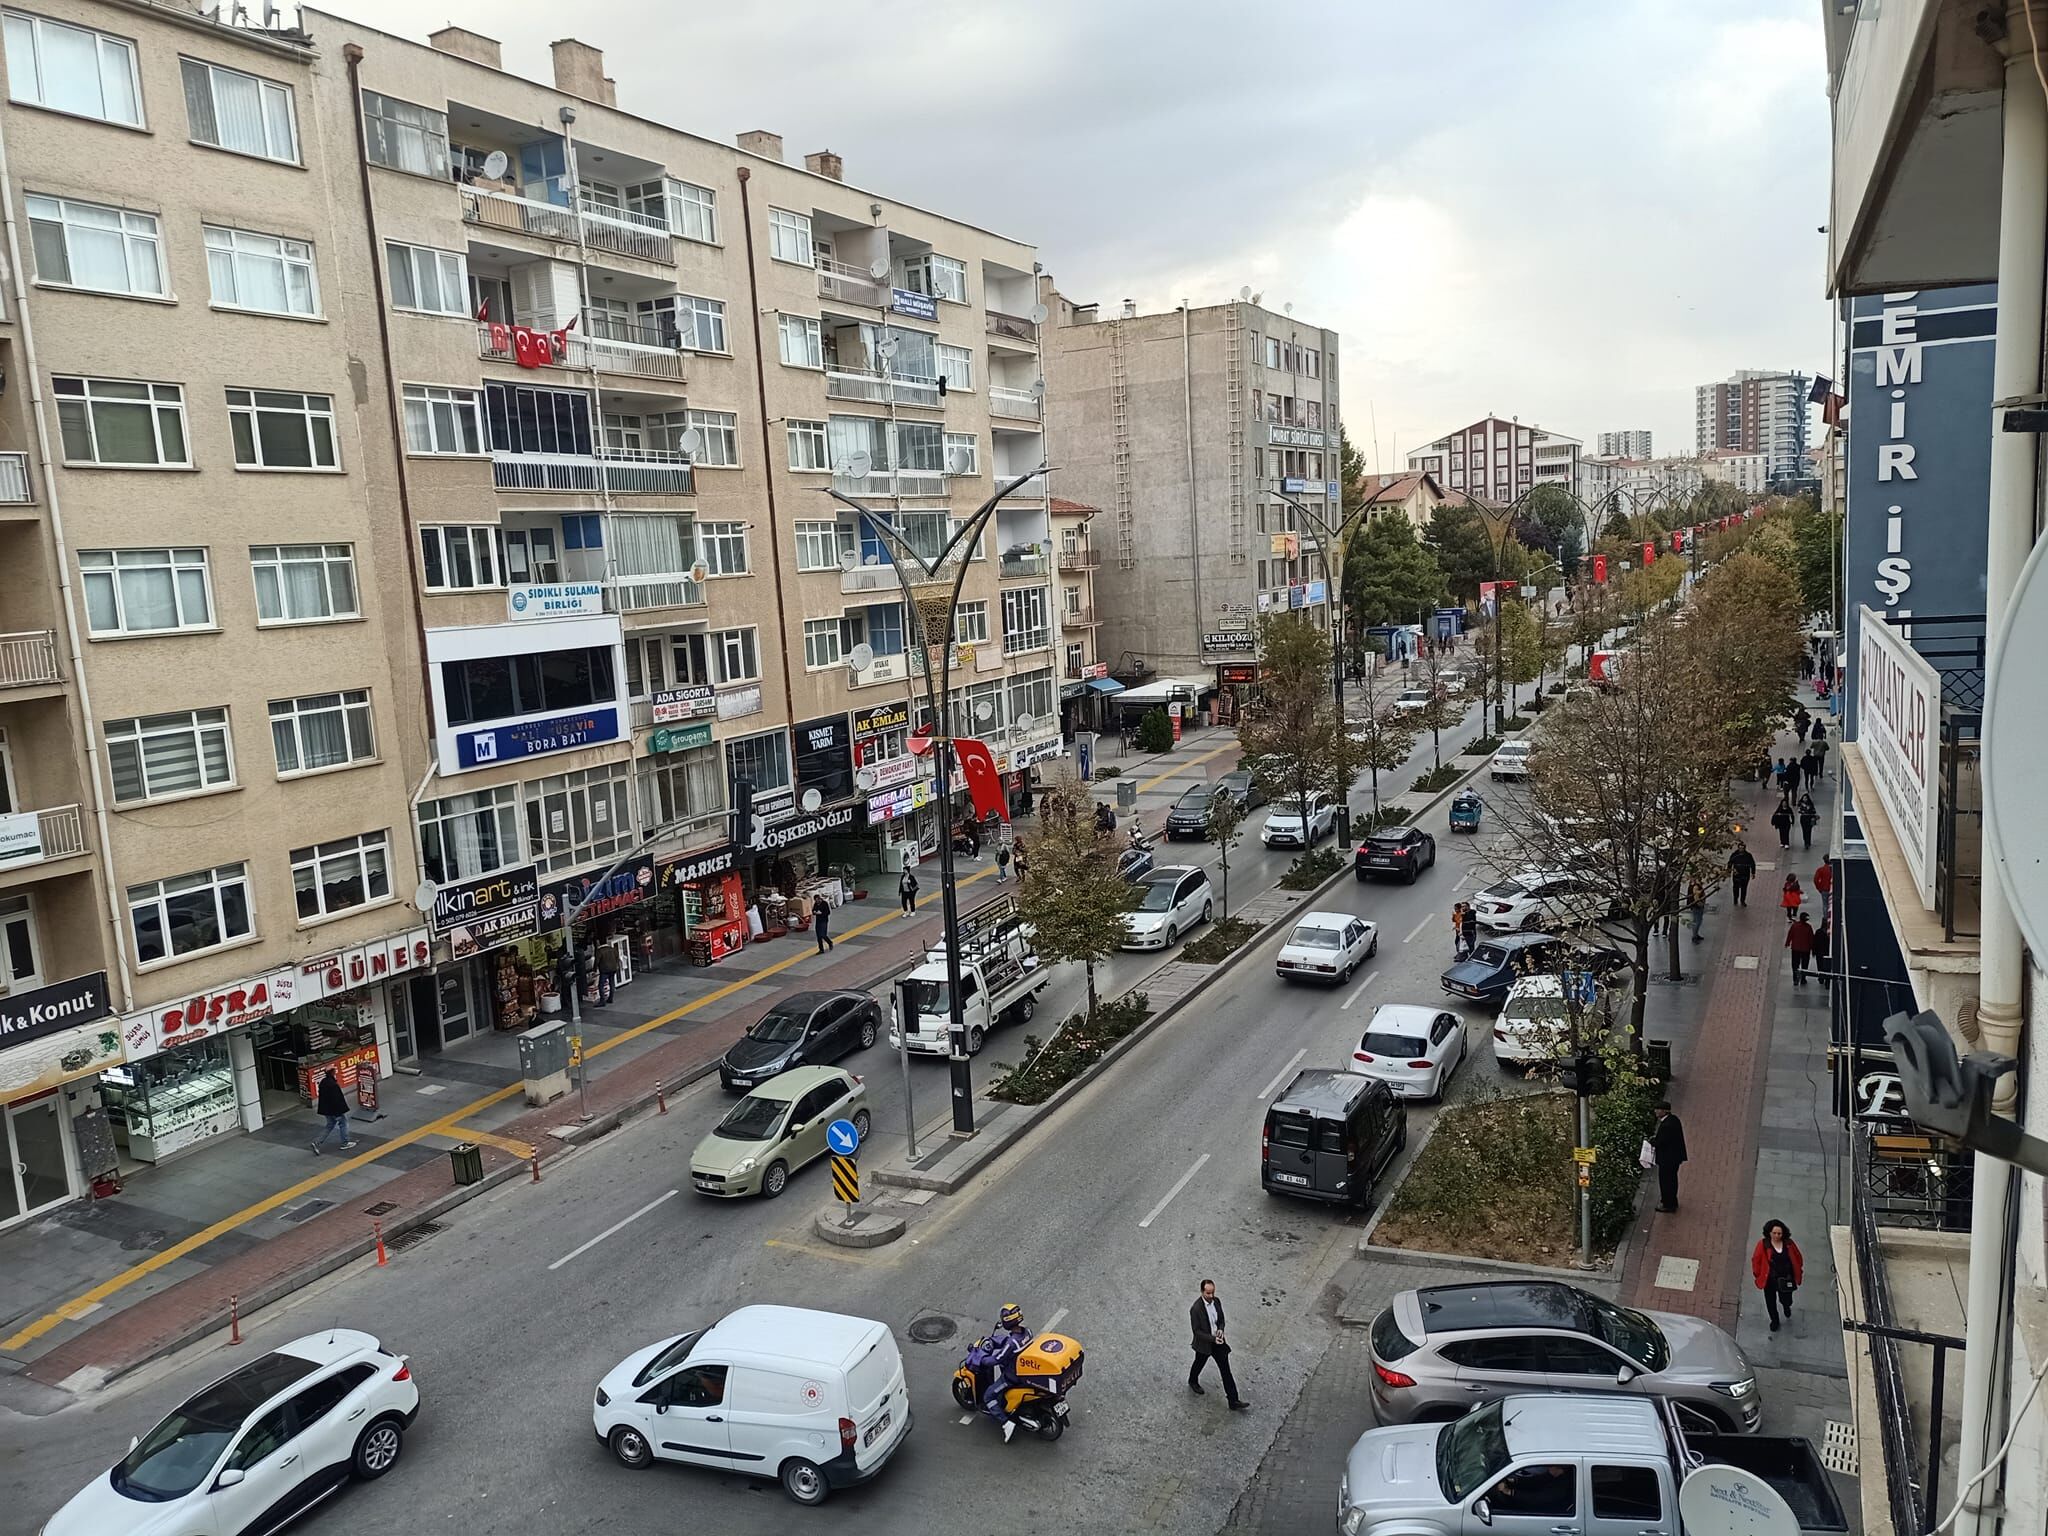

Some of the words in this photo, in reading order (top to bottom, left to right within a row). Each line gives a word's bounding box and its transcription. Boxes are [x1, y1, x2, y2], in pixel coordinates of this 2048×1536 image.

[528, 587, 562, 599] SIDIKLI
[565, 585, 600, 597] SULAMA
[544, 598, 582, 610] BİRLİĞİ
[656, 692, 674, 704] ADA
[856, 720, 872, 733] AK
[872, 711, 907, 728] EMLAK
[671, 730, 707, 745] Groupama
[808, 726, 834, 740] KISMET
[527, 737, 557, 753] BORA
[562, 731, 587, 746] BATI
[811, 737, 833, 751] TARIM
[674, 853, 733, 884] MARKET
[513, 885, 520, 895] &
[520, 881, 535, 893] ink
[483, 919, 498, 934] AK
[499, 908, 535, 929] EMLAK
[327, 940, 428, 988] GÜNEŞ
[0, 1014, 15, 1035] k
[17, 1016, 29, 1030] &
[29, 991, 95, 1026] Konut
[162, 983, 268, 1034] BÜŞRA
[340, 1060, 347, 1069] 5
[364, 1050, 376, 1060] da
[1019, 1358, 1041, 1371] getir
